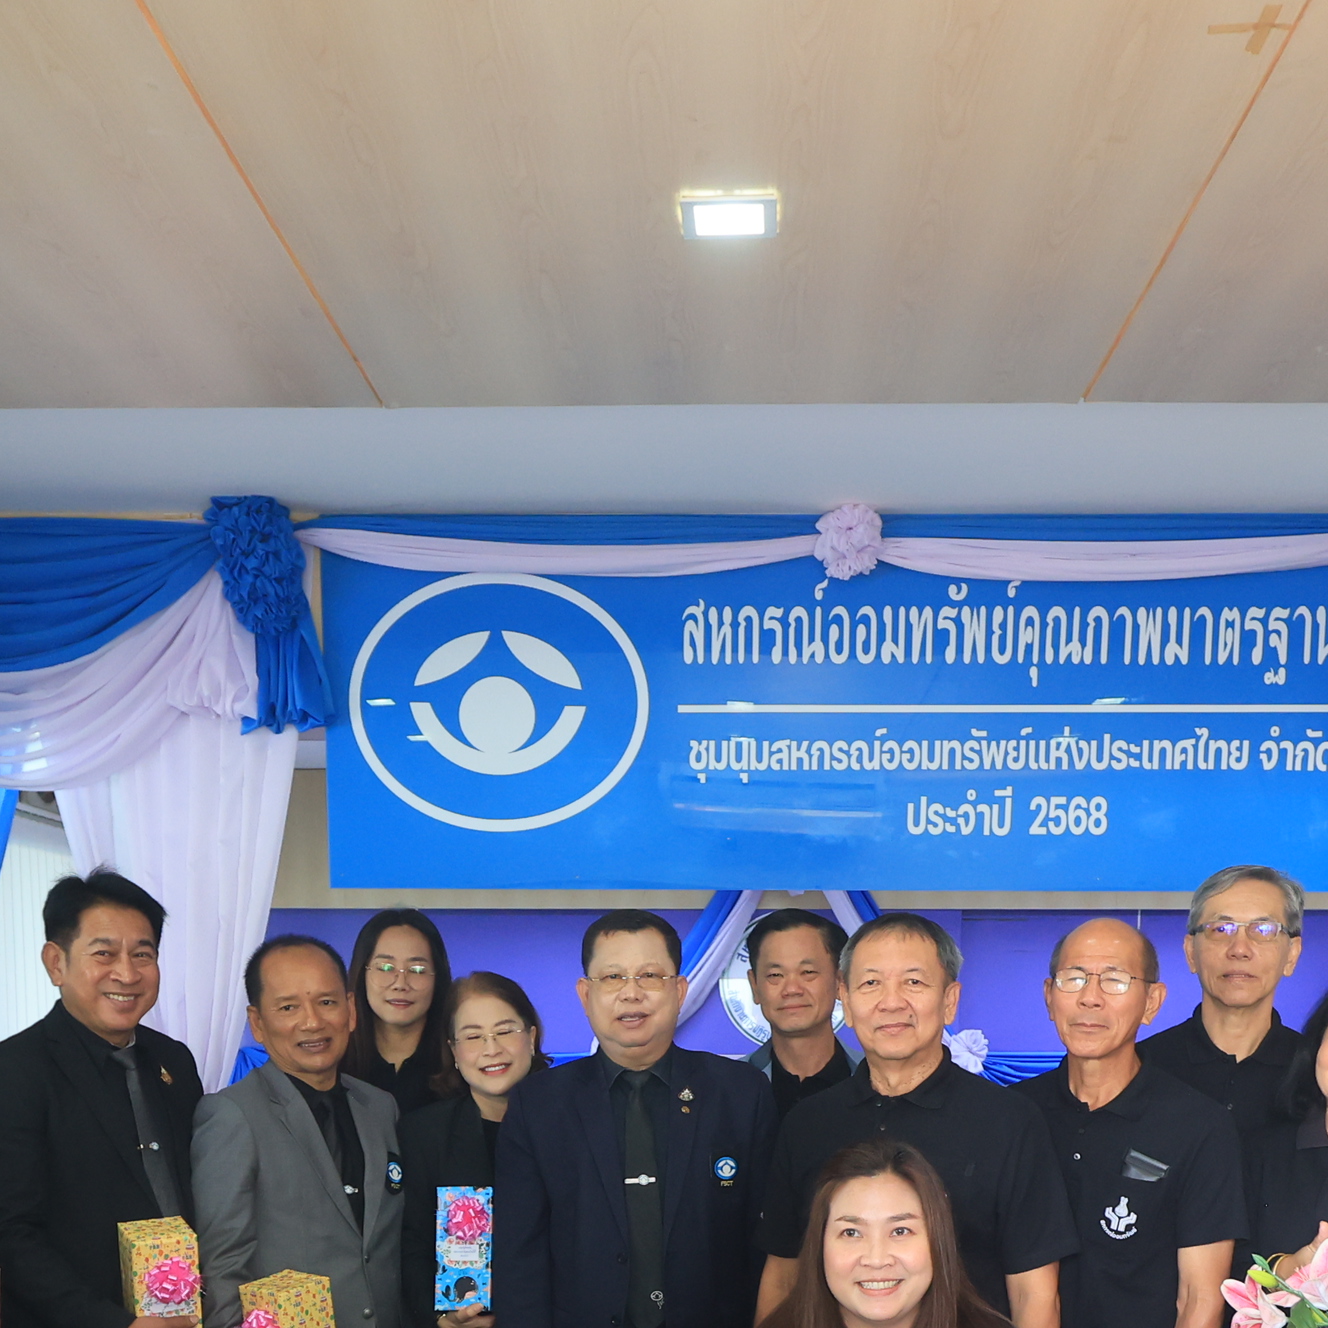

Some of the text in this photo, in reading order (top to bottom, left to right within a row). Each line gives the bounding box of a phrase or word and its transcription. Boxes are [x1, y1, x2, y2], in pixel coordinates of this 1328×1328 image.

[689, 726, 1250, 783] ชุมนุมสหกรณ์ออมทรัพย์แห่งประเทศไทย
[907, 786, 1108, 836] ประจำปี 2568
